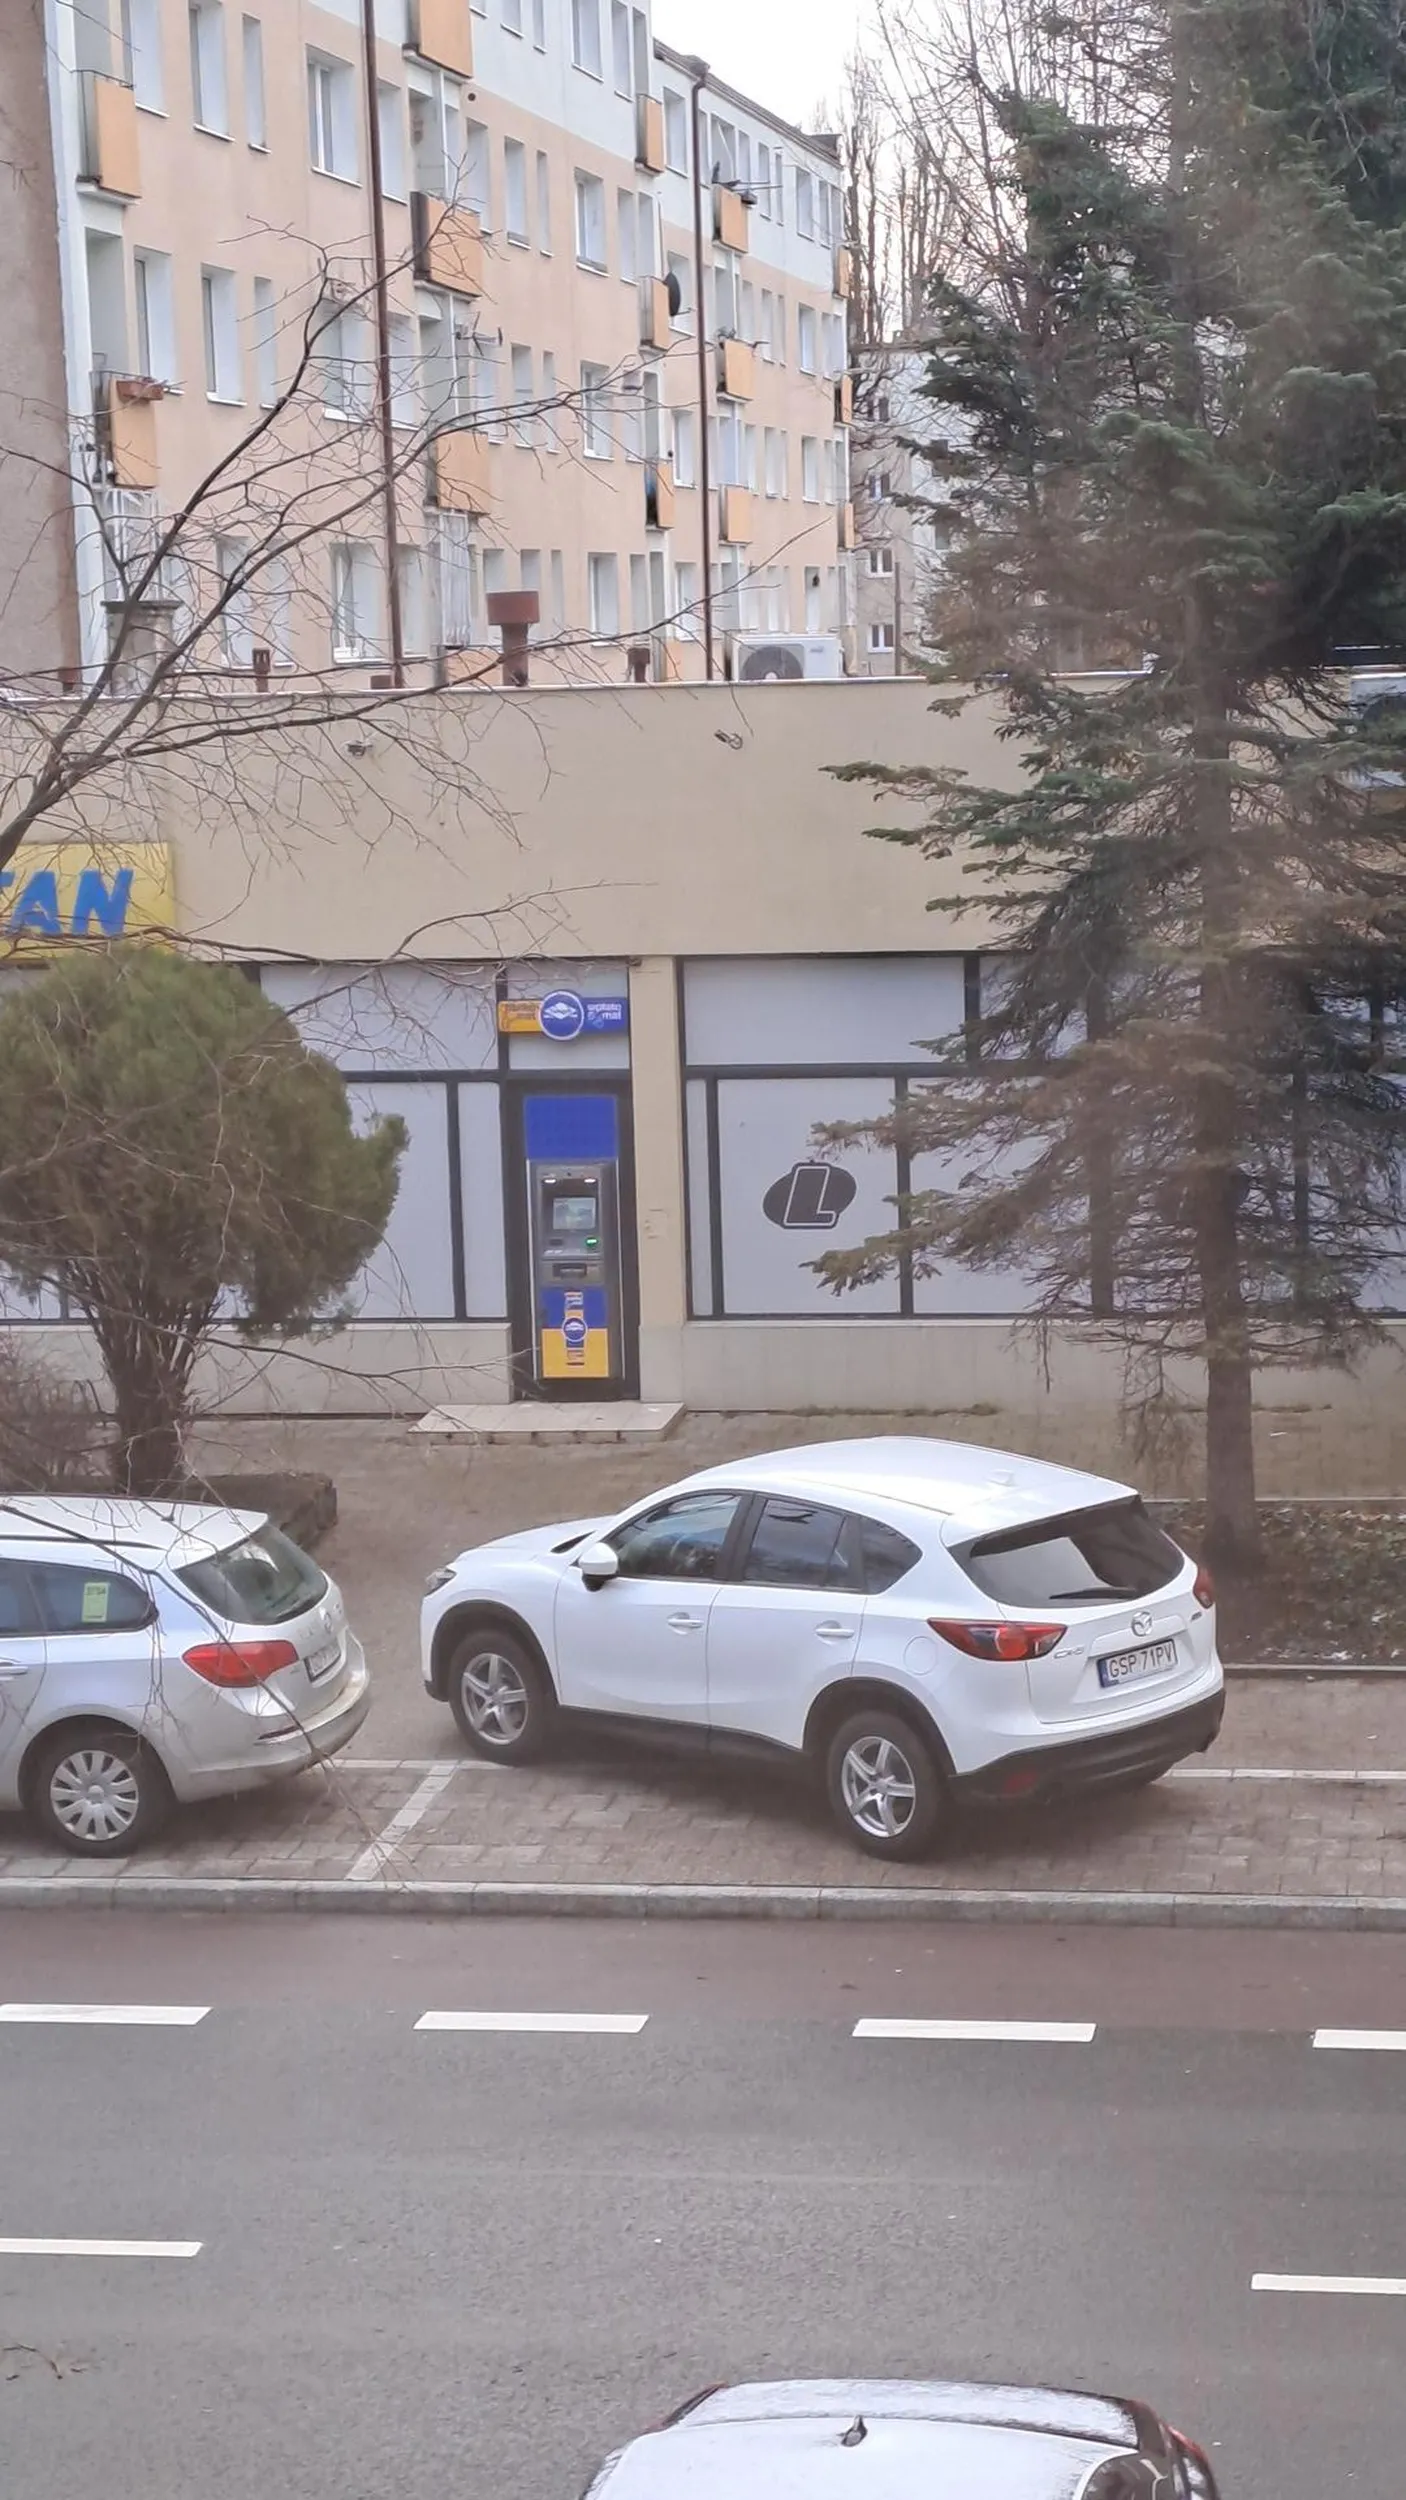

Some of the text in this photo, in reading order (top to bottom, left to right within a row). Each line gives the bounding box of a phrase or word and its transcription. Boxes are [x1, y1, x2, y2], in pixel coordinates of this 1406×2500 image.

[0, 870, 133, 937] AN
[783, 1165, 837, 1227] L
[1109, 1643, 1173, 1679] GSP 71PV
